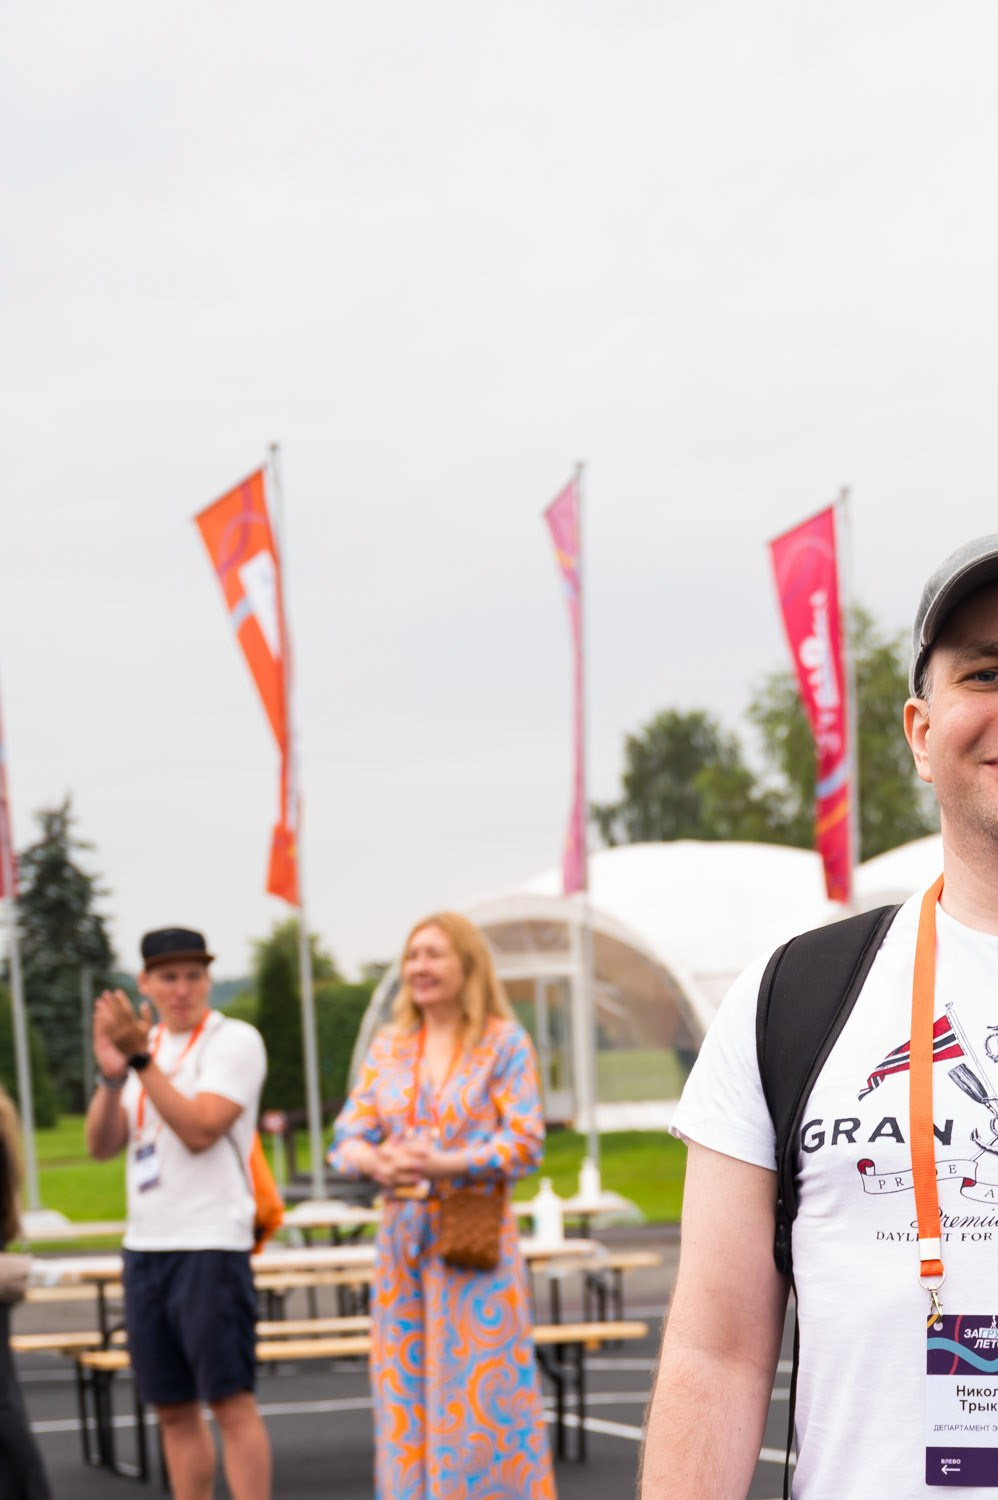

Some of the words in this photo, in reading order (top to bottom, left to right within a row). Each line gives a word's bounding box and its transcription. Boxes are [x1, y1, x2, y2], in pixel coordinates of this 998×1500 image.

[878, 1164, 957, 1189] PRE
[876, 1231, 952, 1242] DAYLIT
[961, 1231, 992, 1242] FOR
[933, 1424, 990, 1432] ДЕПАРТАМЕНТ
